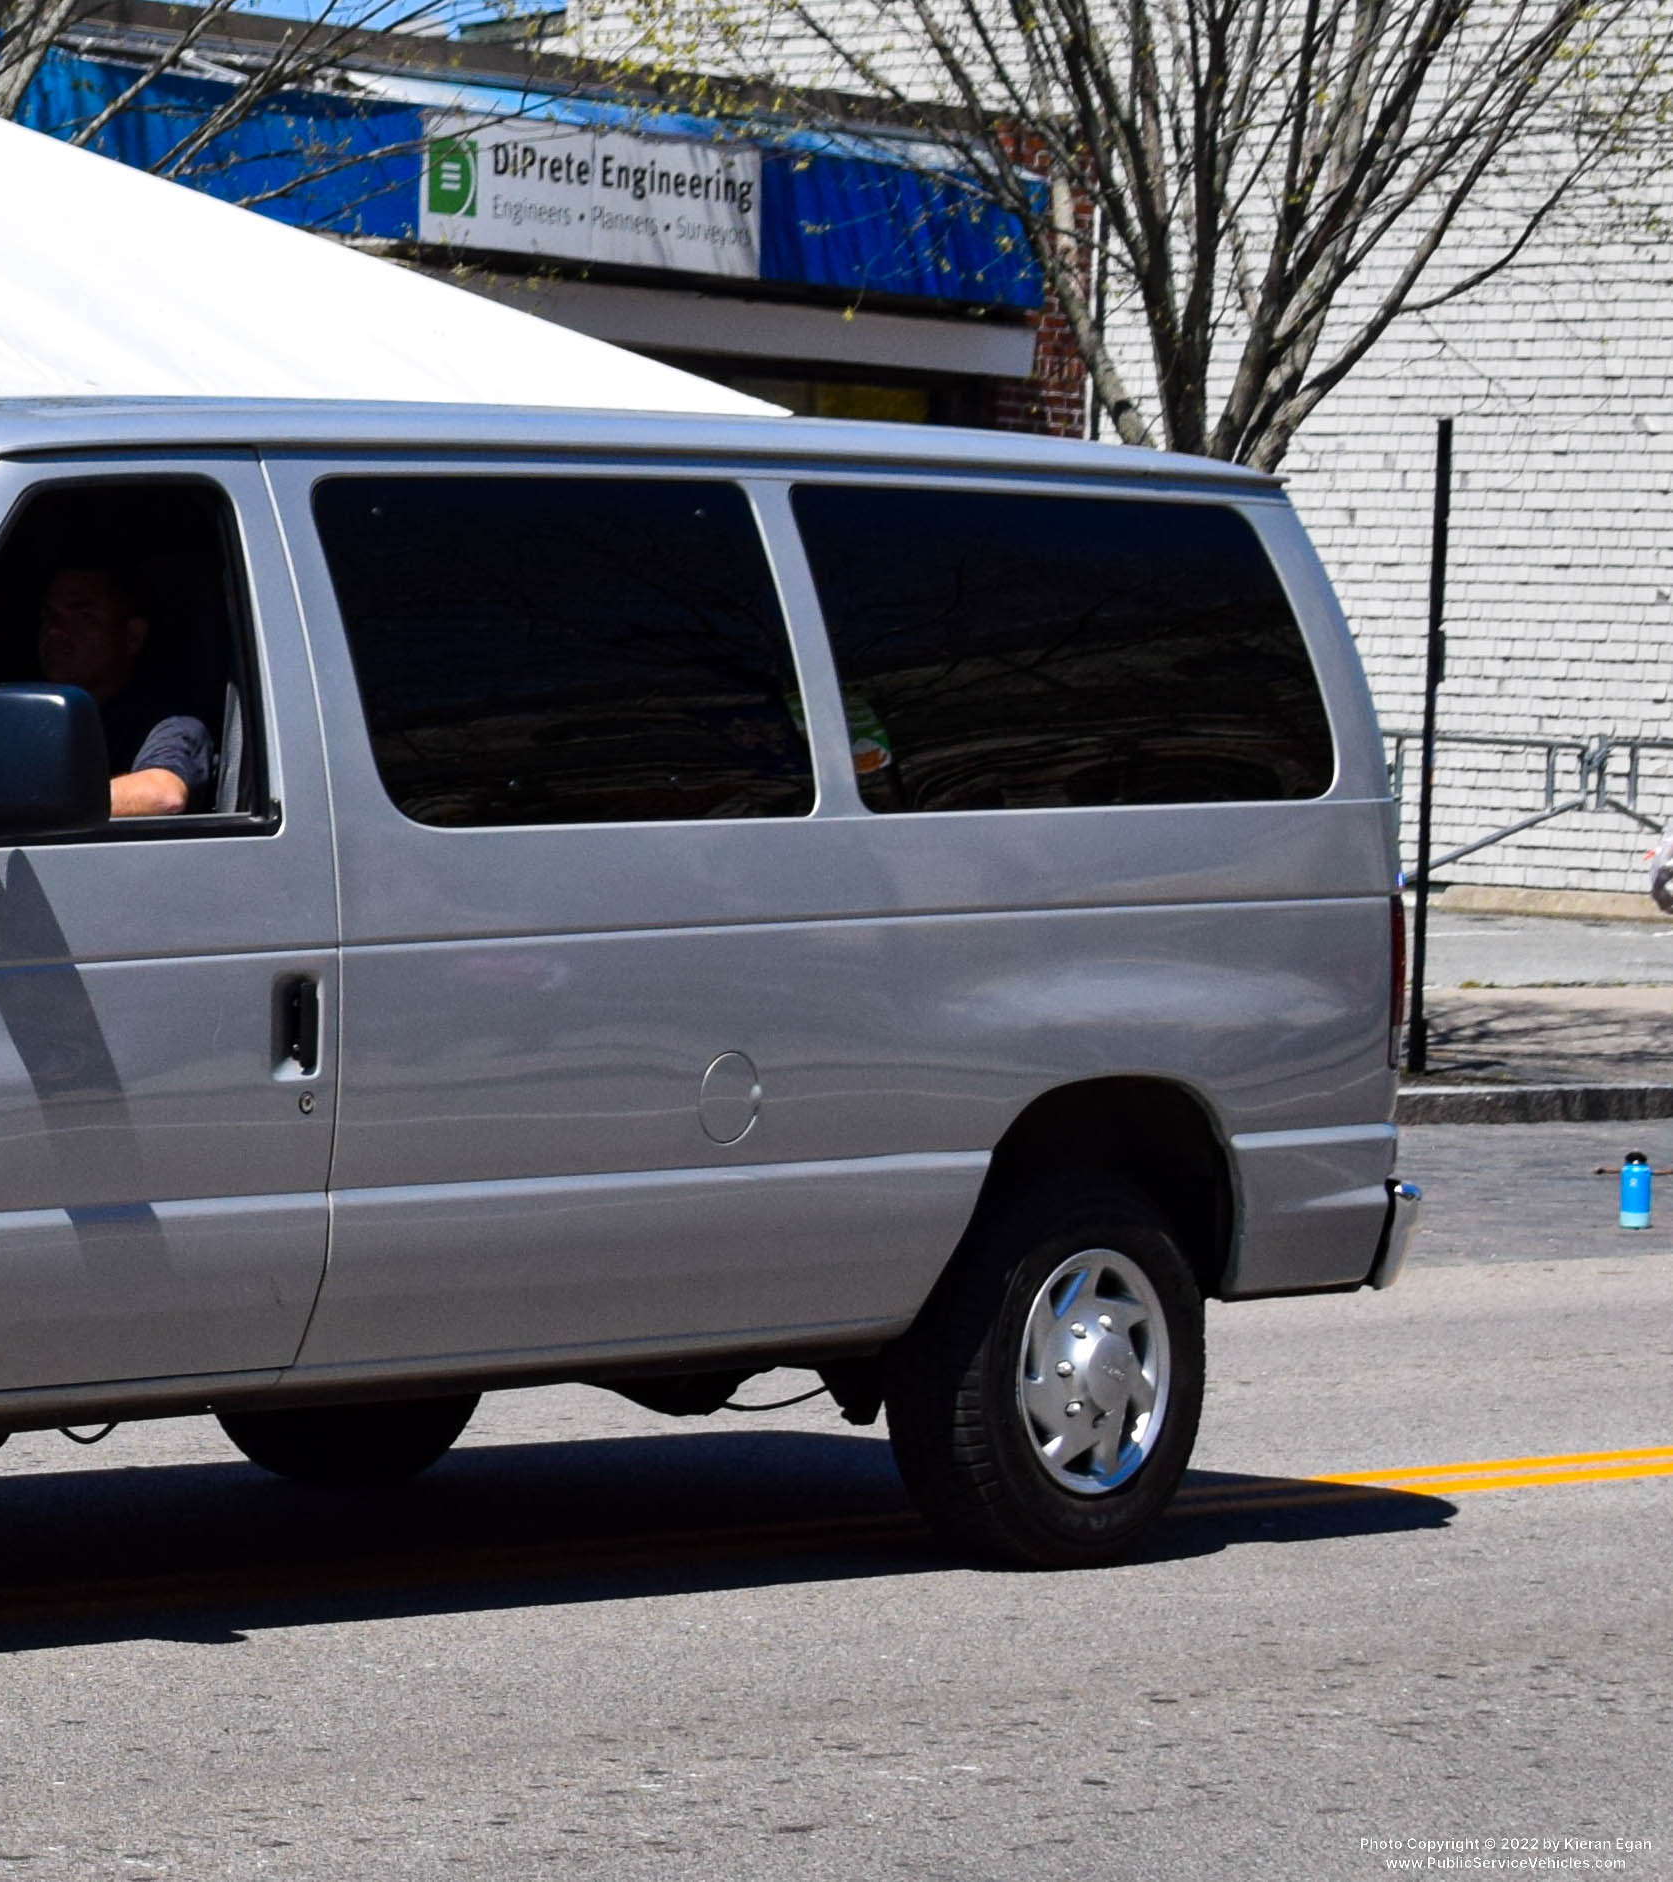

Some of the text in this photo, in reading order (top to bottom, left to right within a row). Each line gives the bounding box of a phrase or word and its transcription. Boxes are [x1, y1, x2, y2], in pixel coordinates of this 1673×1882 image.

[492, 143, 754, 214] DiPrete Engineering
[492, 194, 753, 247] Engineers Planners Surveyors
